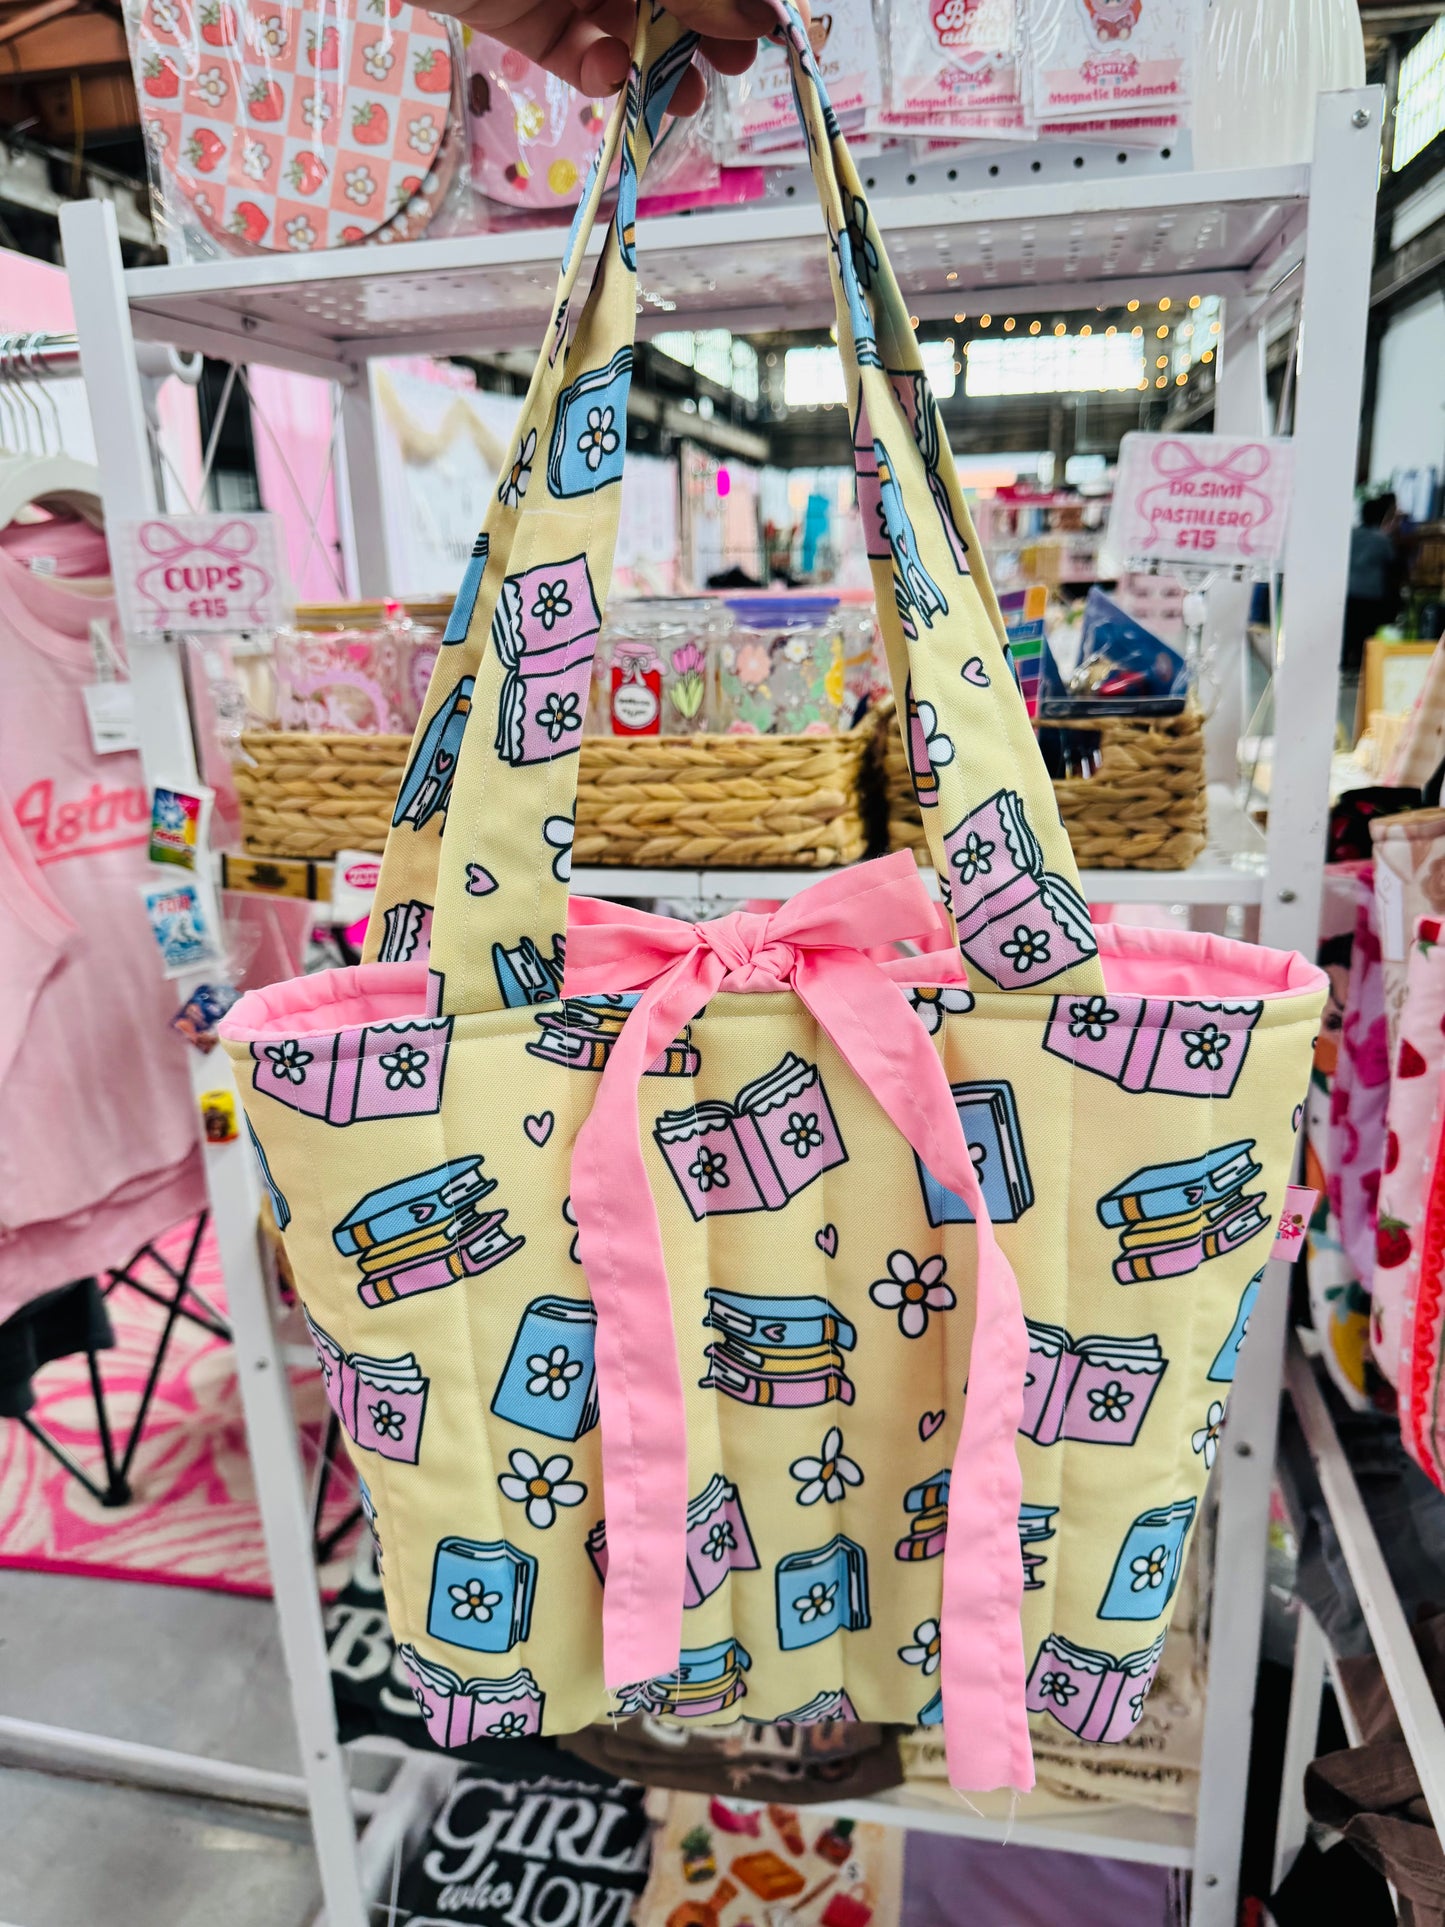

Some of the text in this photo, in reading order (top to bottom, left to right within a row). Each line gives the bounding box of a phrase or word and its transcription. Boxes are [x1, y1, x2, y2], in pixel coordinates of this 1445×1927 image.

[1089, 63, 1130, 76] BONITA
[1049, 81, 1178, 105] Magnetic Bookmark
[905, 95, 964, 110] Magnetic
[878, 112, 1024, 129] Magnetic Bookmark
[1110, 114, 1178, 130] Bookmark
[1151, 507, 1253, 527] PASTILLERO
[164, 565, 243, 593] CUPS
[438, 1859, 515, 1912] who
